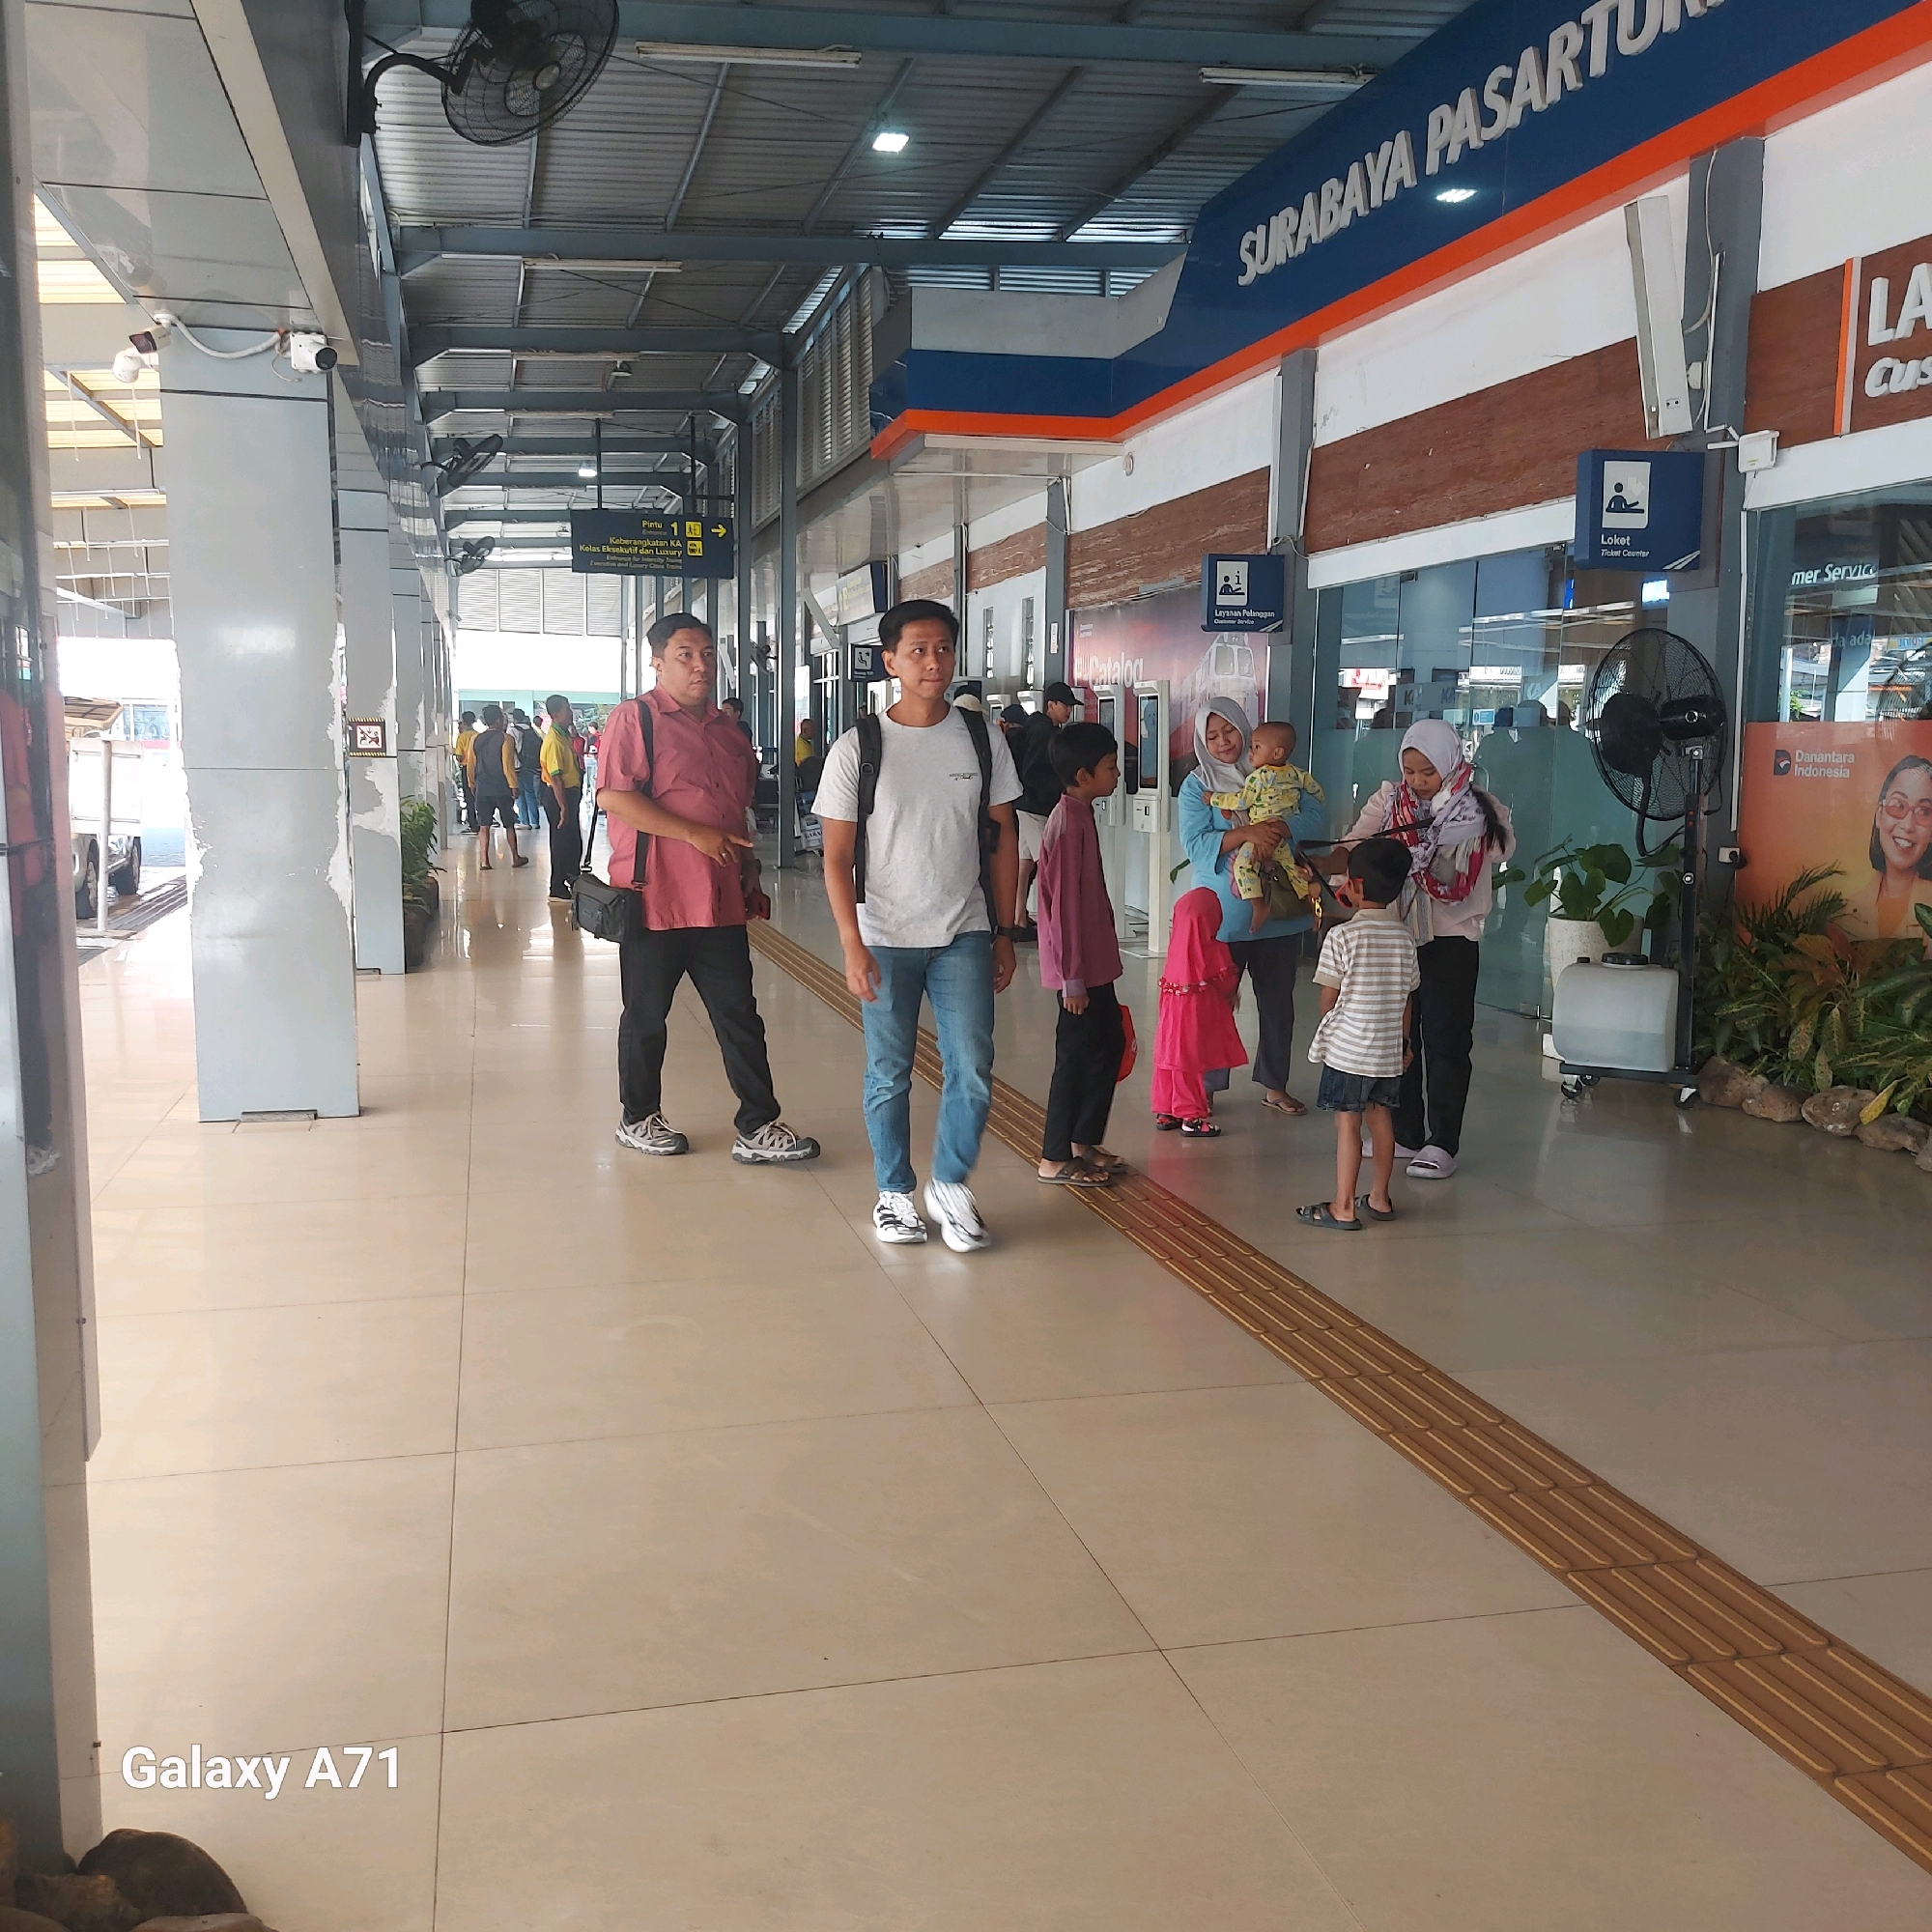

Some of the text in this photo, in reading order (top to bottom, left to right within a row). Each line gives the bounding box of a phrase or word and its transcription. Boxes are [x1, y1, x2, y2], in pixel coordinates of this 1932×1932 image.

[1238, 0, 1725, 287] SURABAYA PASARTU
[641, 520, 678, 536] Pintu 1
[609, 536, 682, 548] Keberangkatan KA
[1601, 533, 1631, 547] Loket
[580, 543, 682, 557] Kelas Eksekutif dan Luxury
[1601, 549, 1650, 557] Ticket Counter
[1242, 609, 1275, 619] Pelanggan
[1795, 749, 1856, 764] Danantara
[1794, 763, 1851, 779] Indonesia
